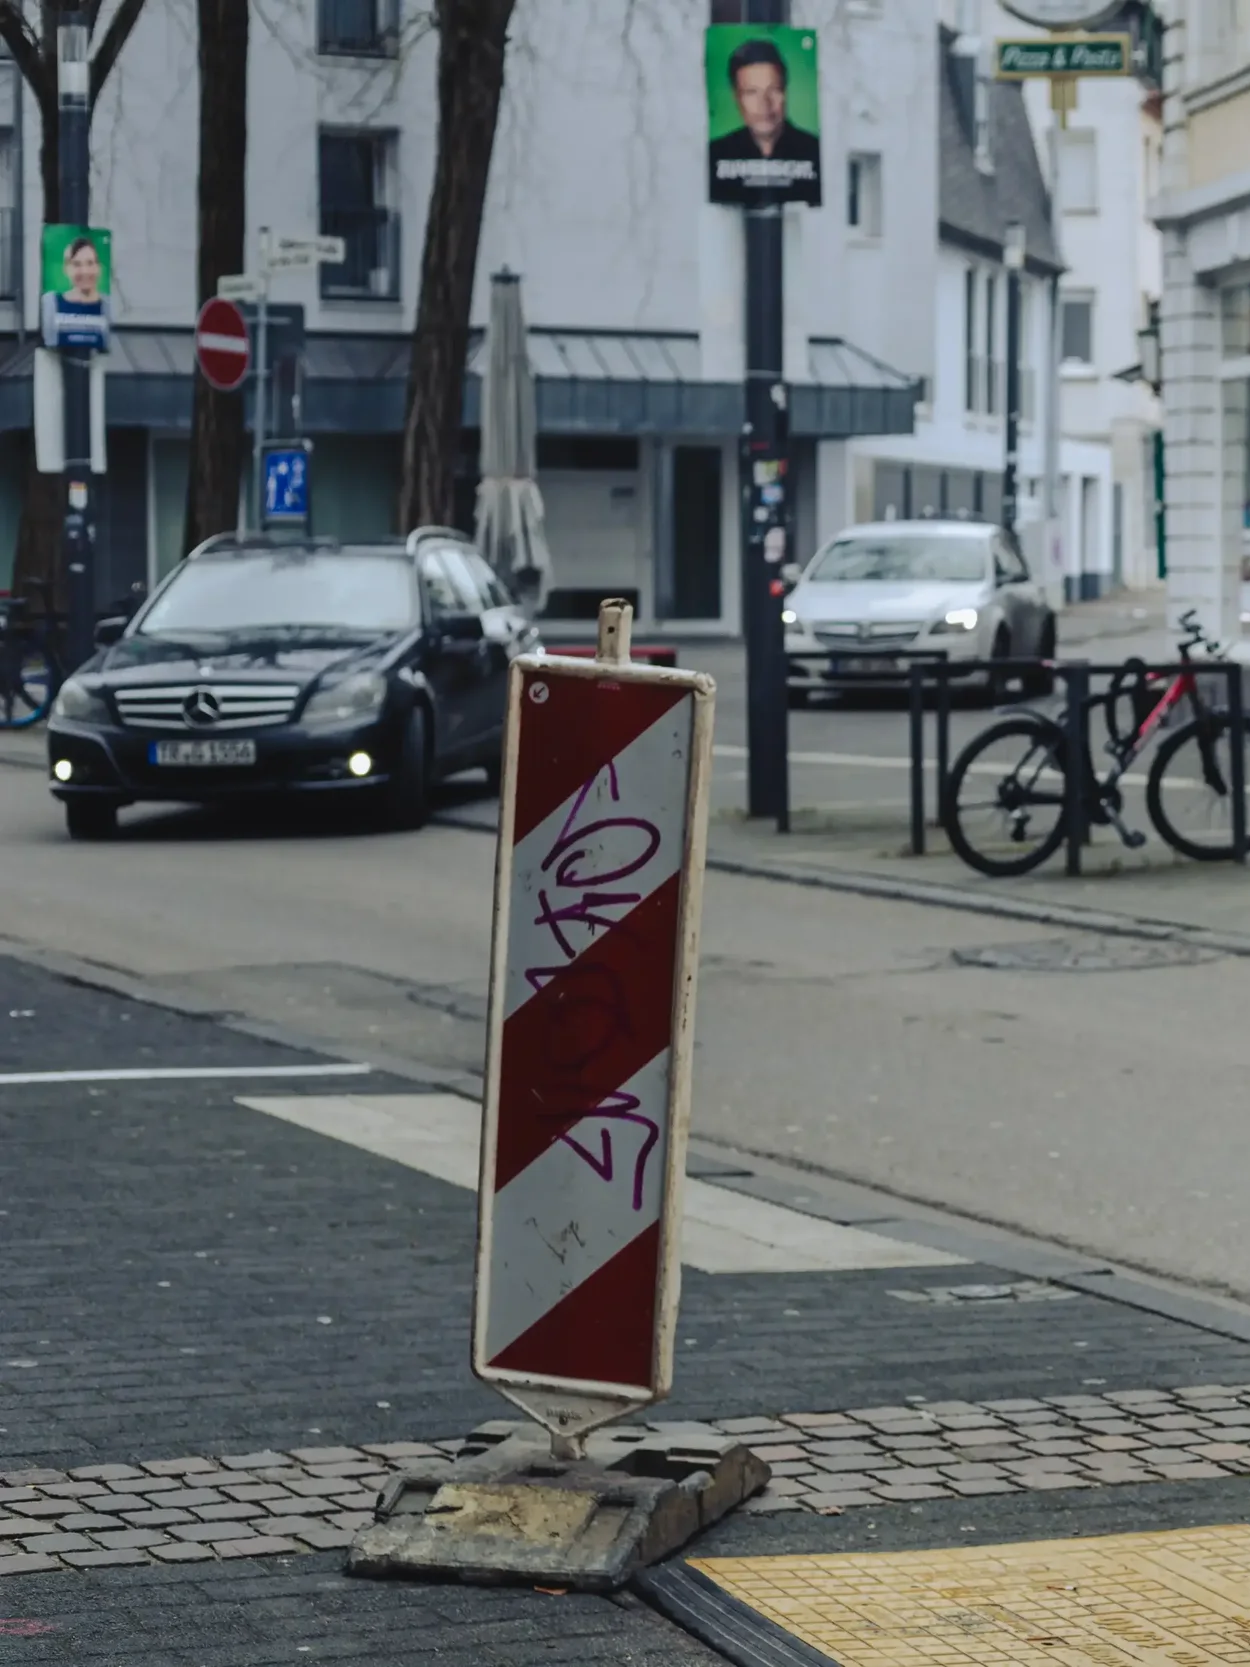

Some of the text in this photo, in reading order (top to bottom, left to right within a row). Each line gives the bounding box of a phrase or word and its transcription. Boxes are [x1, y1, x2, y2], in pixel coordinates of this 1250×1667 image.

[1003, 45, 1120, 67] Pizza & Pasta
